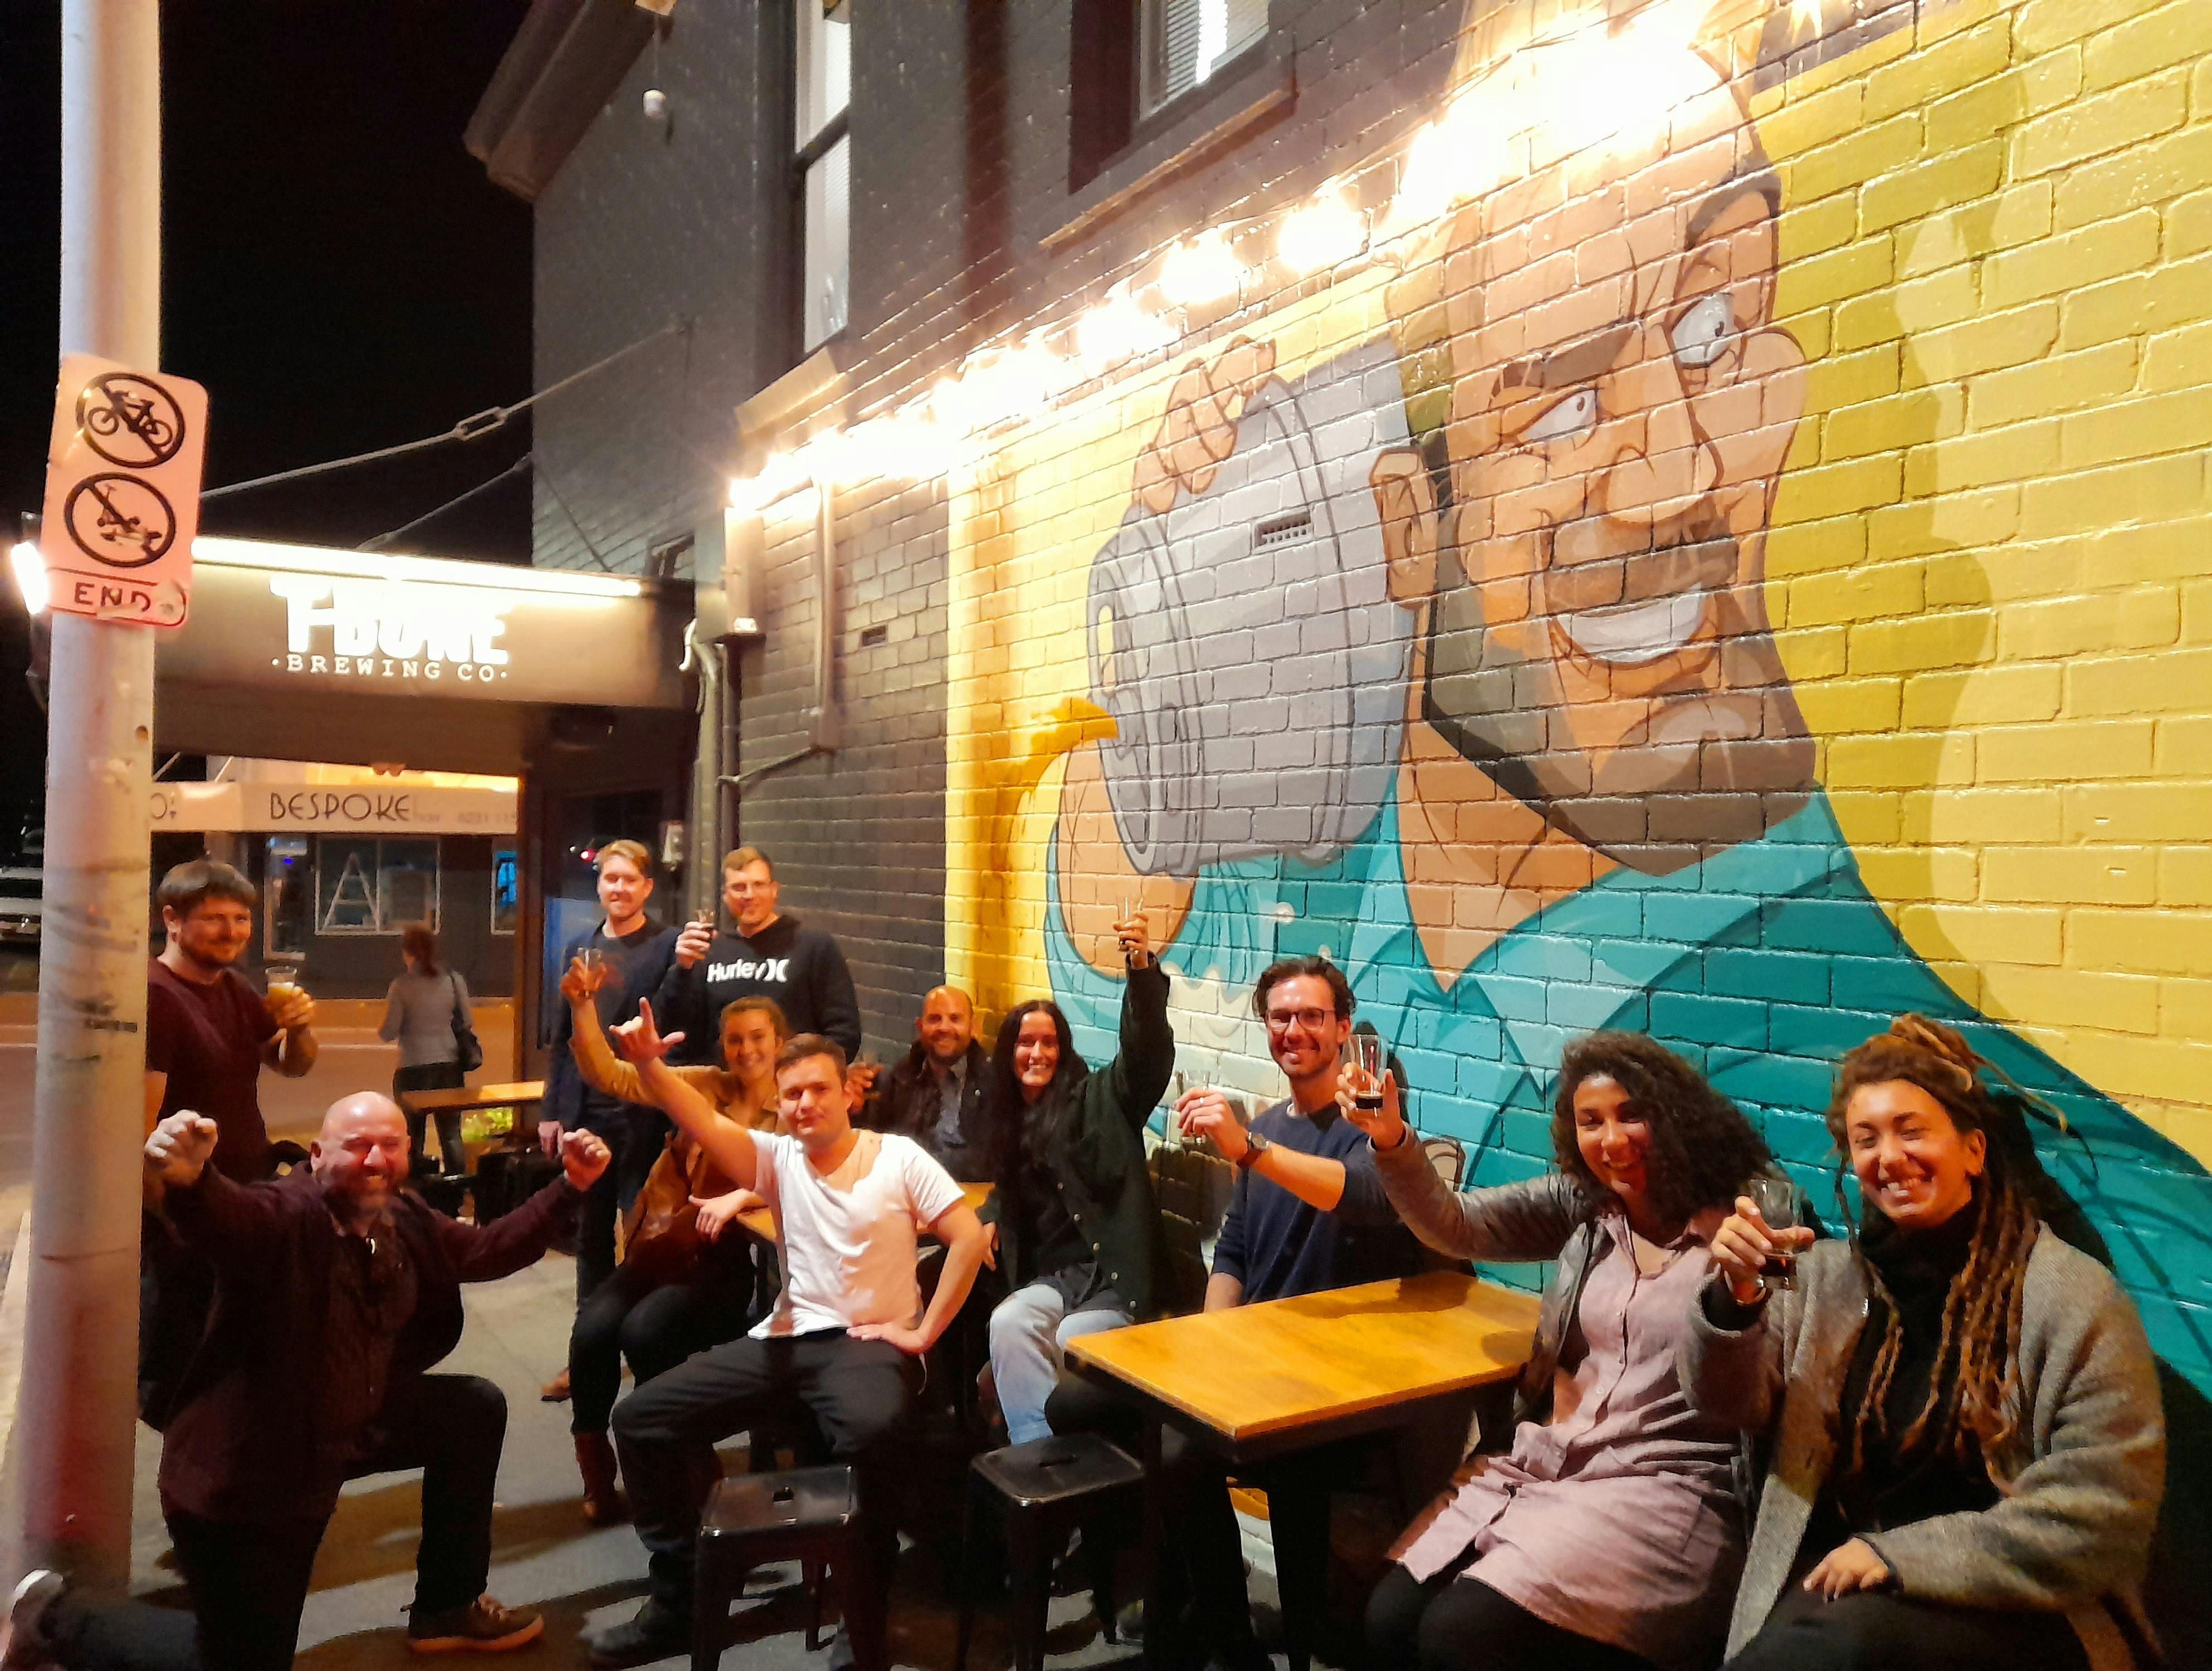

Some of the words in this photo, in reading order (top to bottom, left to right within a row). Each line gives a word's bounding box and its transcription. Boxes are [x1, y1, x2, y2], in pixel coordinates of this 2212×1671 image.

[74, 582, 151, 612] END
[270, 791, 411, 822] BESPOKE
[706, 958, 767, 983] Hurley
